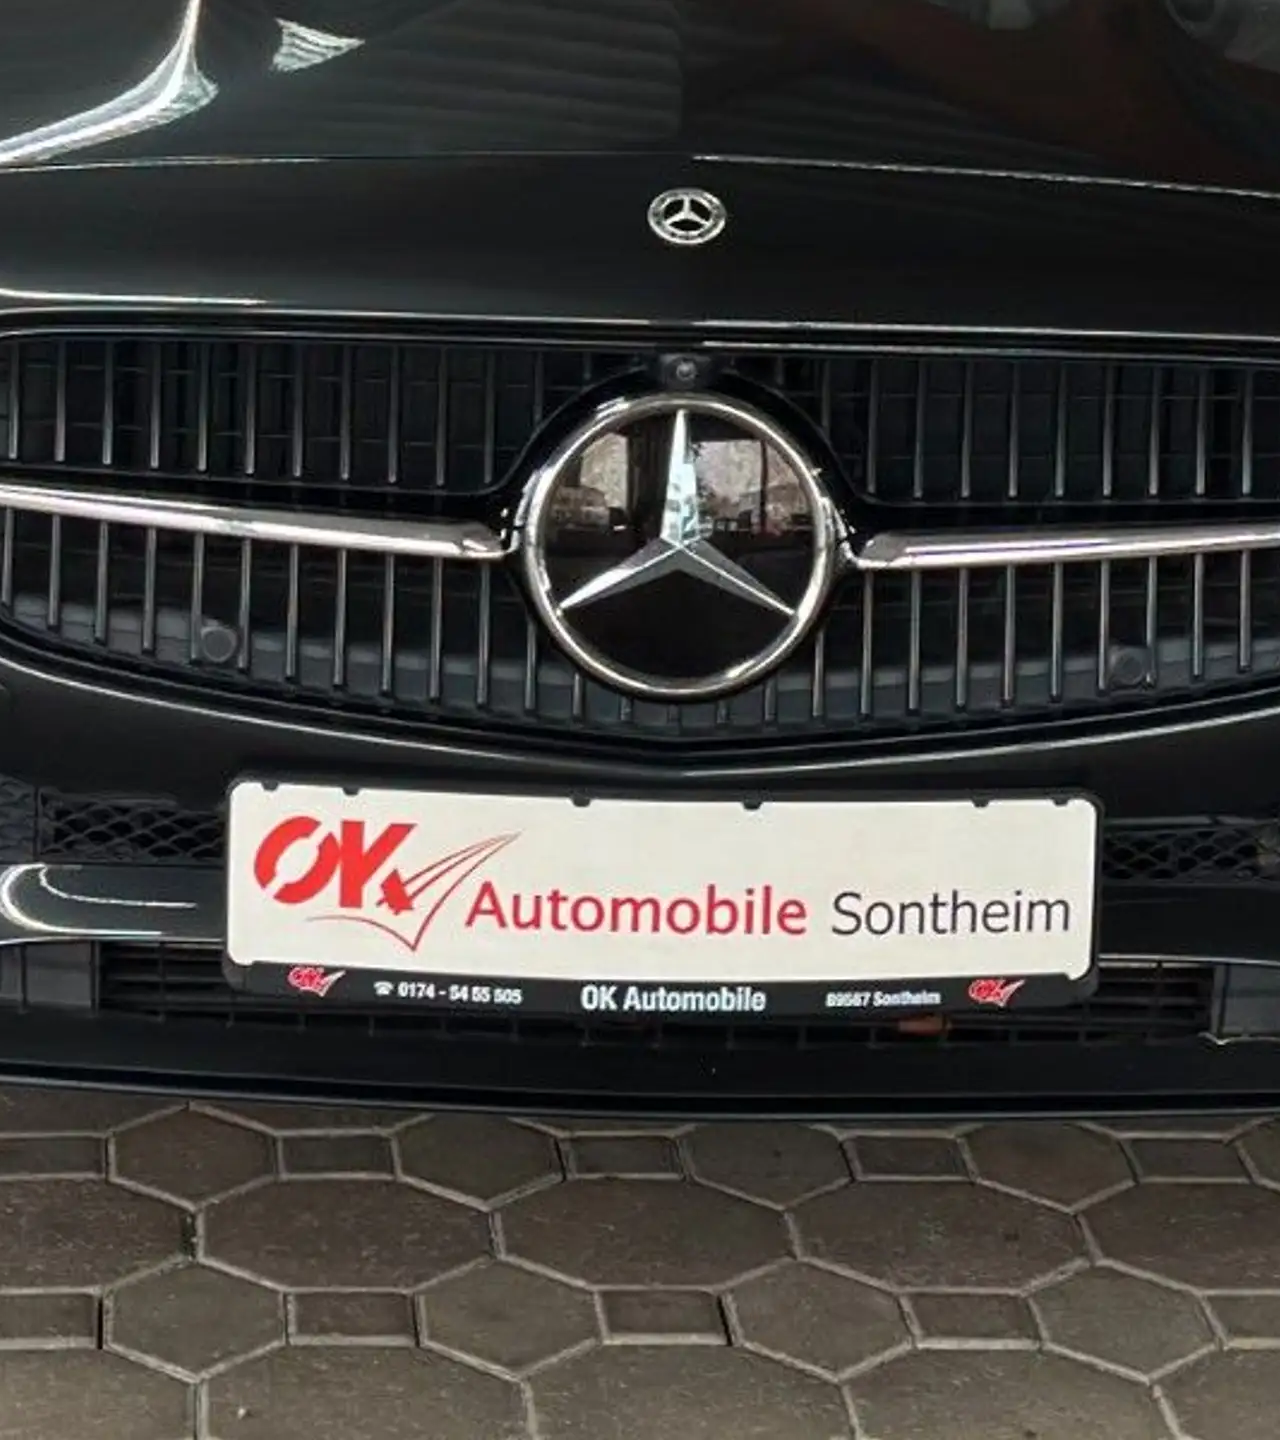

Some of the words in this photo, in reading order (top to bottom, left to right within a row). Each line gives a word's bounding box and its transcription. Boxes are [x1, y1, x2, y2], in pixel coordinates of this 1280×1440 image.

[465, 880, 807, 936] Automobile
[830, 888, 1071, 936] Sontheim
[397, 980, 435, 999] 0174
[448, 984, 469, 1002] 54
[493, 987, 522, 1005] 505
[580, 983, 618, 1011] OK
[623, 985, 766, 1012] Automobile
[872, 990, 941, 1007] Sontheim
